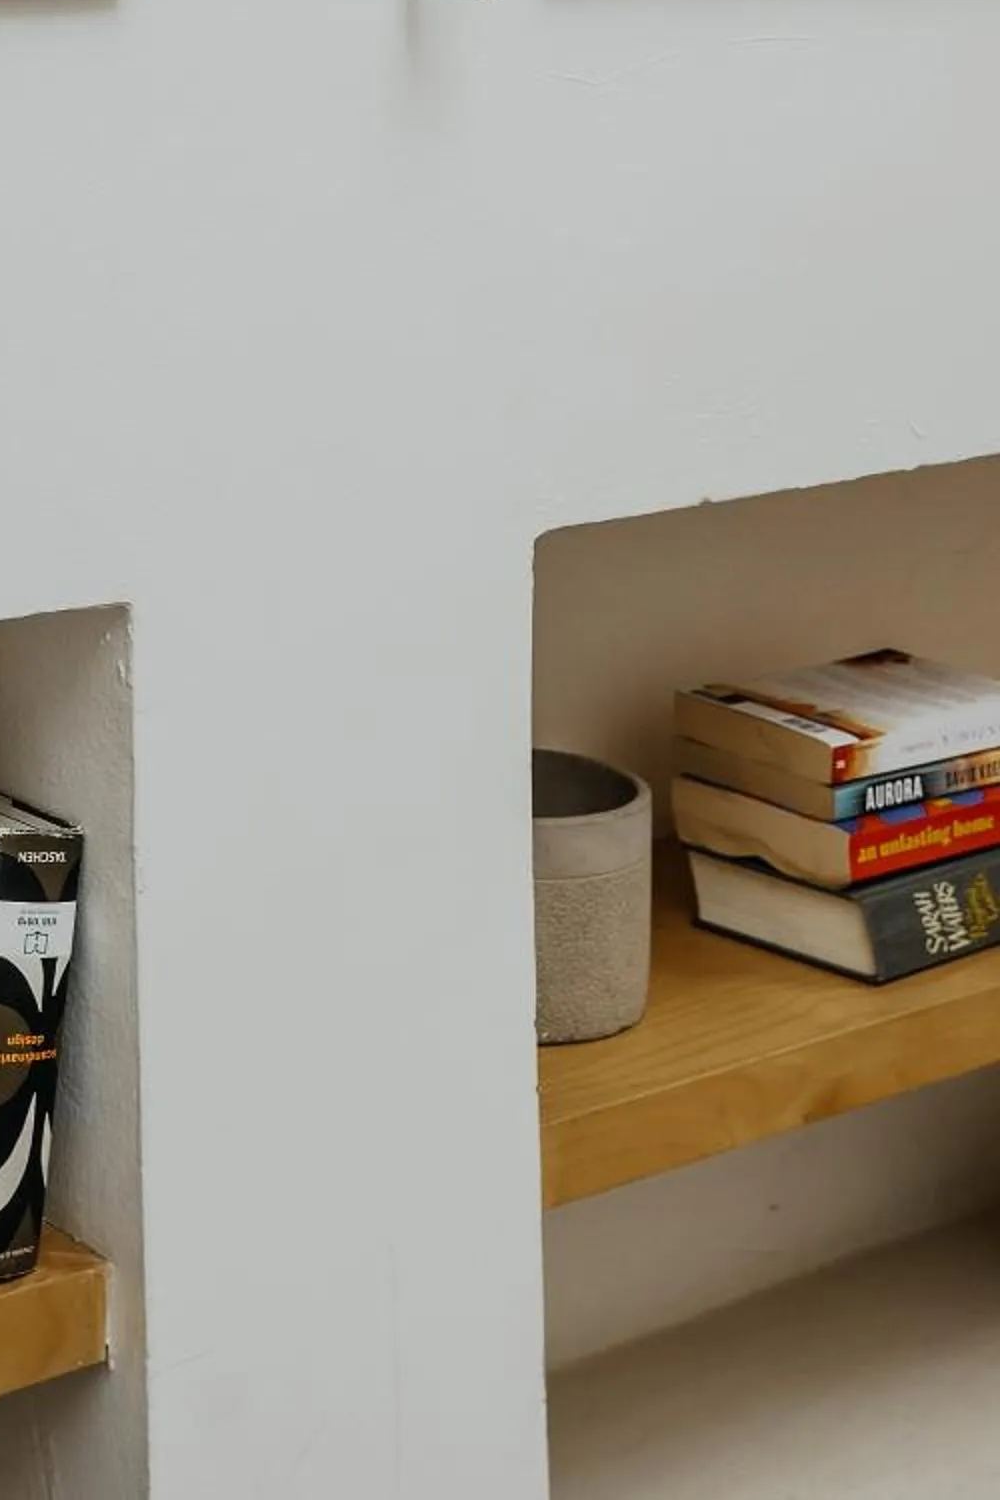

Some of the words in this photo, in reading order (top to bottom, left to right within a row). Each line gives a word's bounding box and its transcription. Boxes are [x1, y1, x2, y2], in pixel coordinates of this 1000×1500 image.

[865, 774, 924, 812] AURORA
[17, 851, 67, 863] TASCHEN
[857, 846, 878, 864] an
[879, 824, 952, 857] unlasting
[911, 890, 946, 954] SARAH
[933, 881, 971, 953] WATERS
[6, 1032, 45, 1048] design
